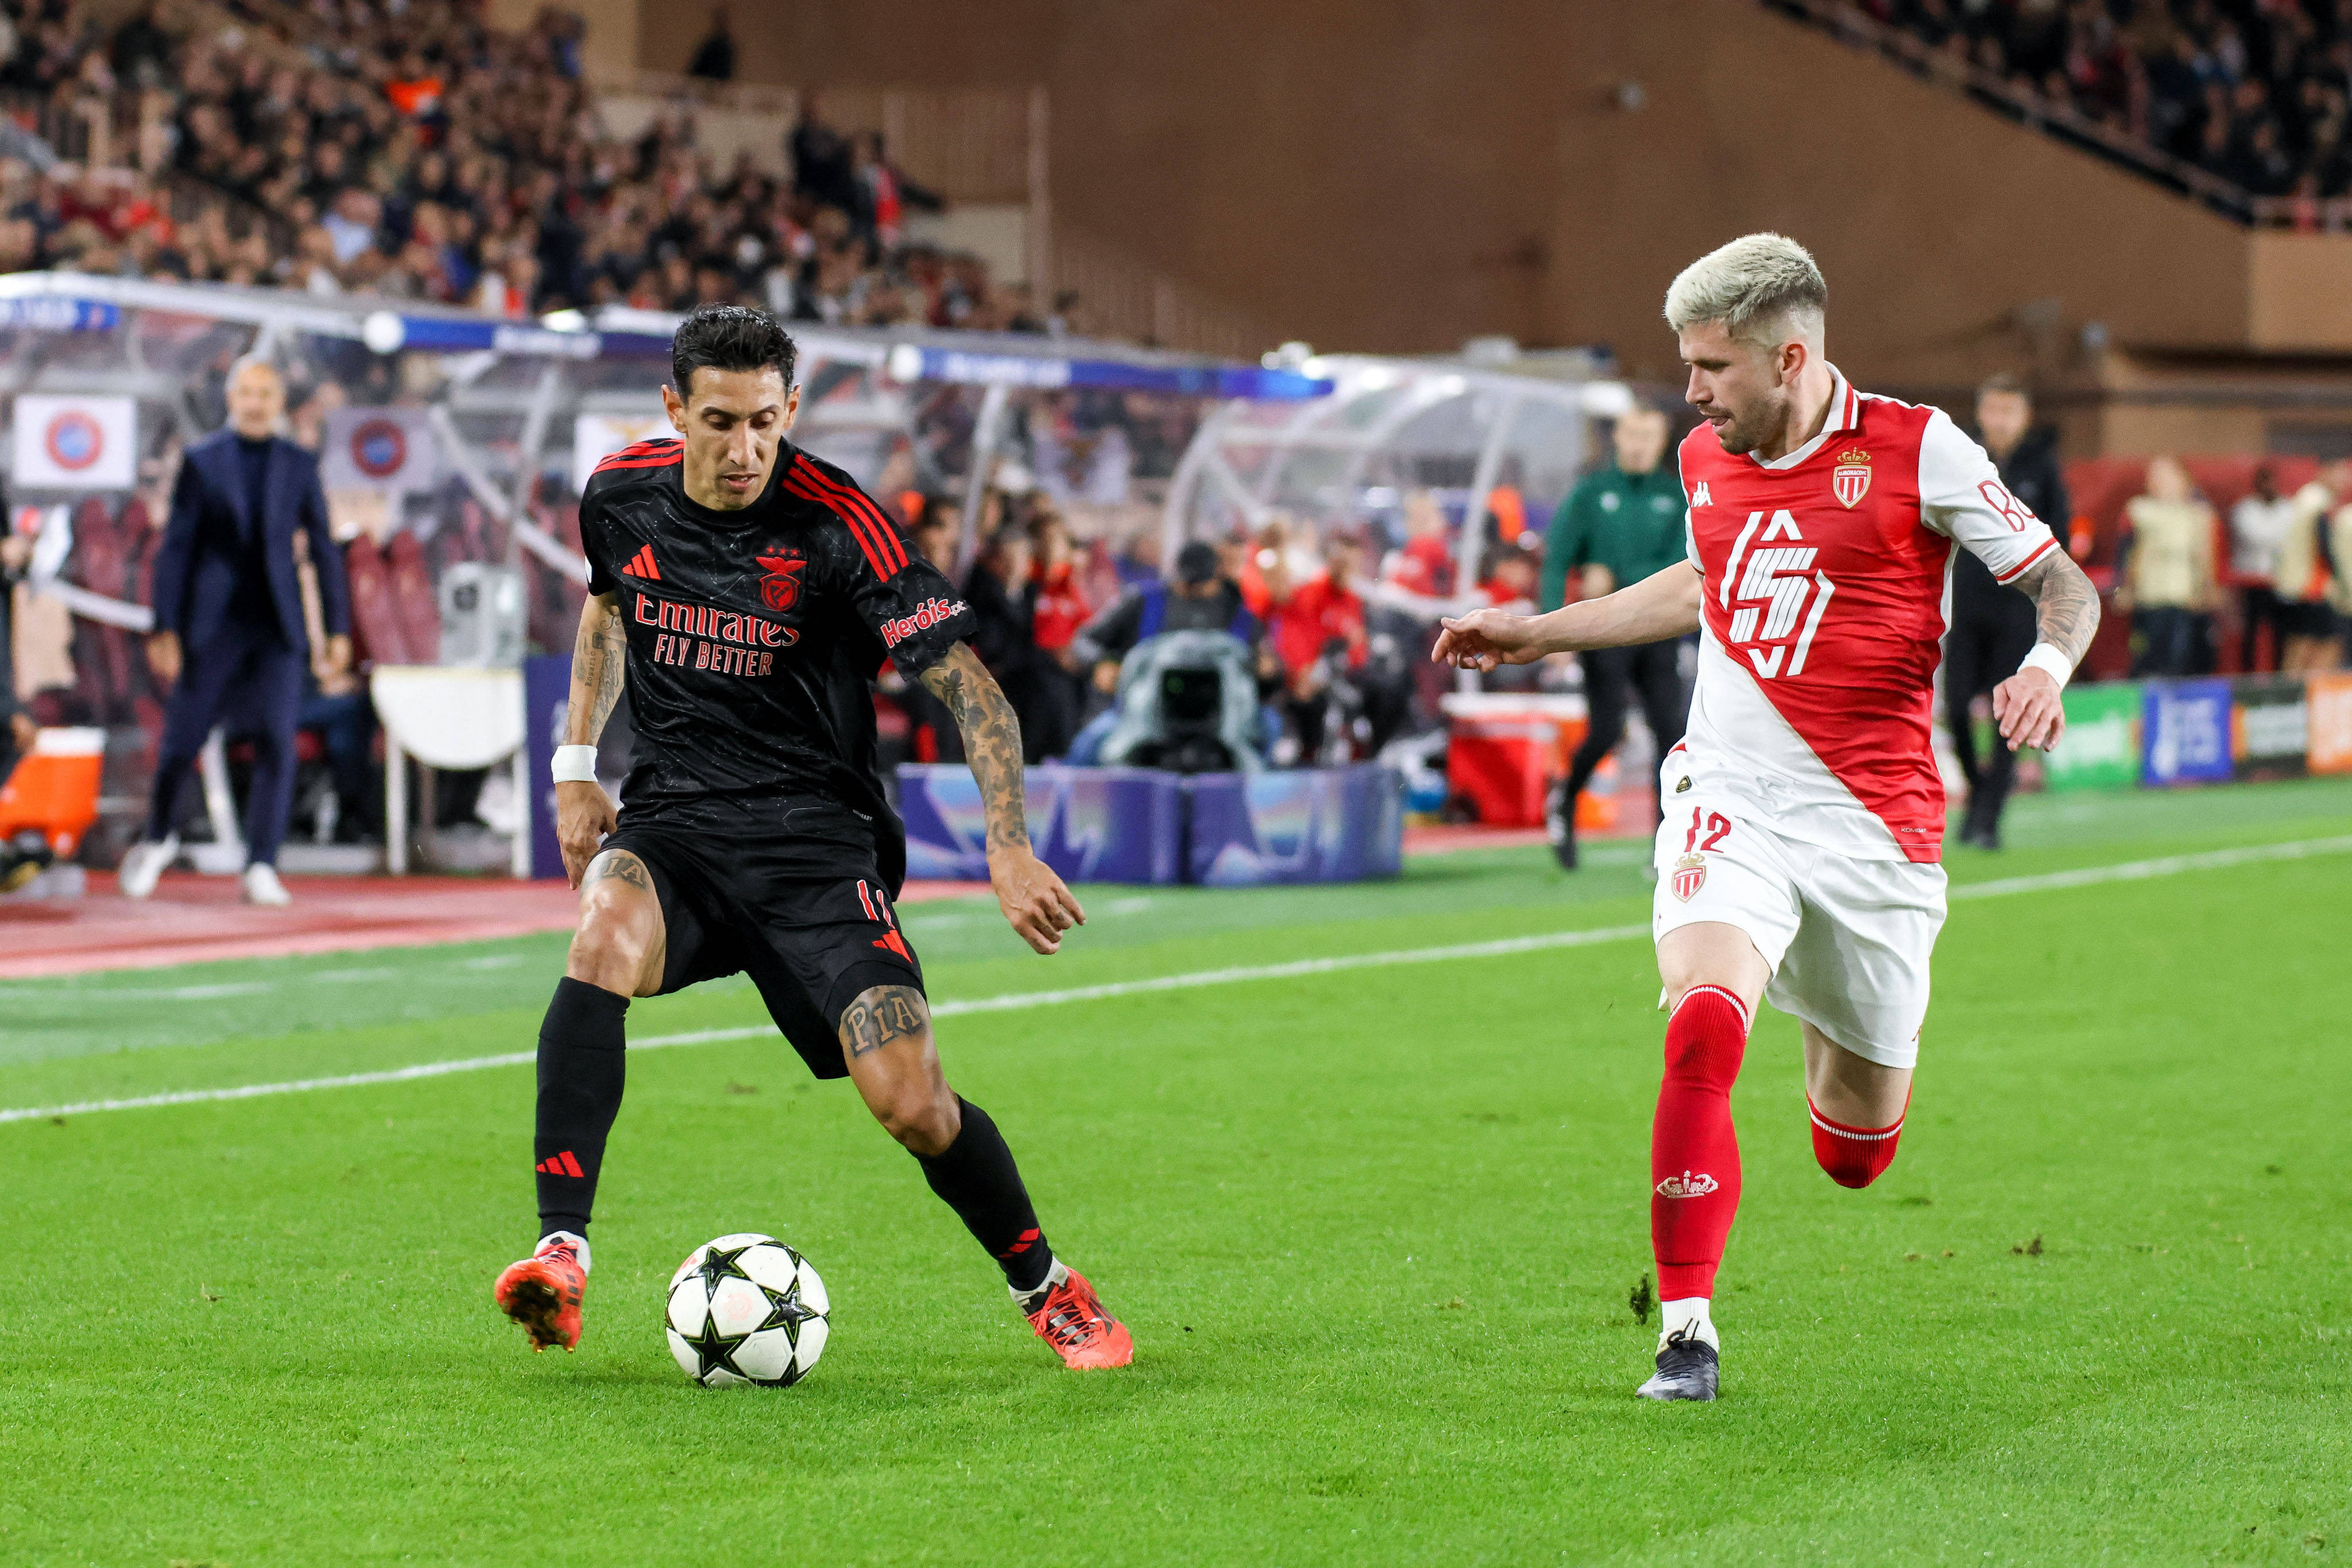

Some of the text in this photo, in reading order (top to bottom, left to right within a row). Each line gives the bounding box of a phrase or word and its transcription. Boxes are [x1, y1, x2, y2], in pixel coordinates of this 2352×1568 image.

[635, 593, 800, 647] Emirates
[880, 597, 968, 649] Heróis.pt
[654, 633, 773, 676] FLY BETTER
[1684, 806, 1731, 853] 12
[856, 879, 896, 930] 11
[846, 994, 921, 1053] PIA
